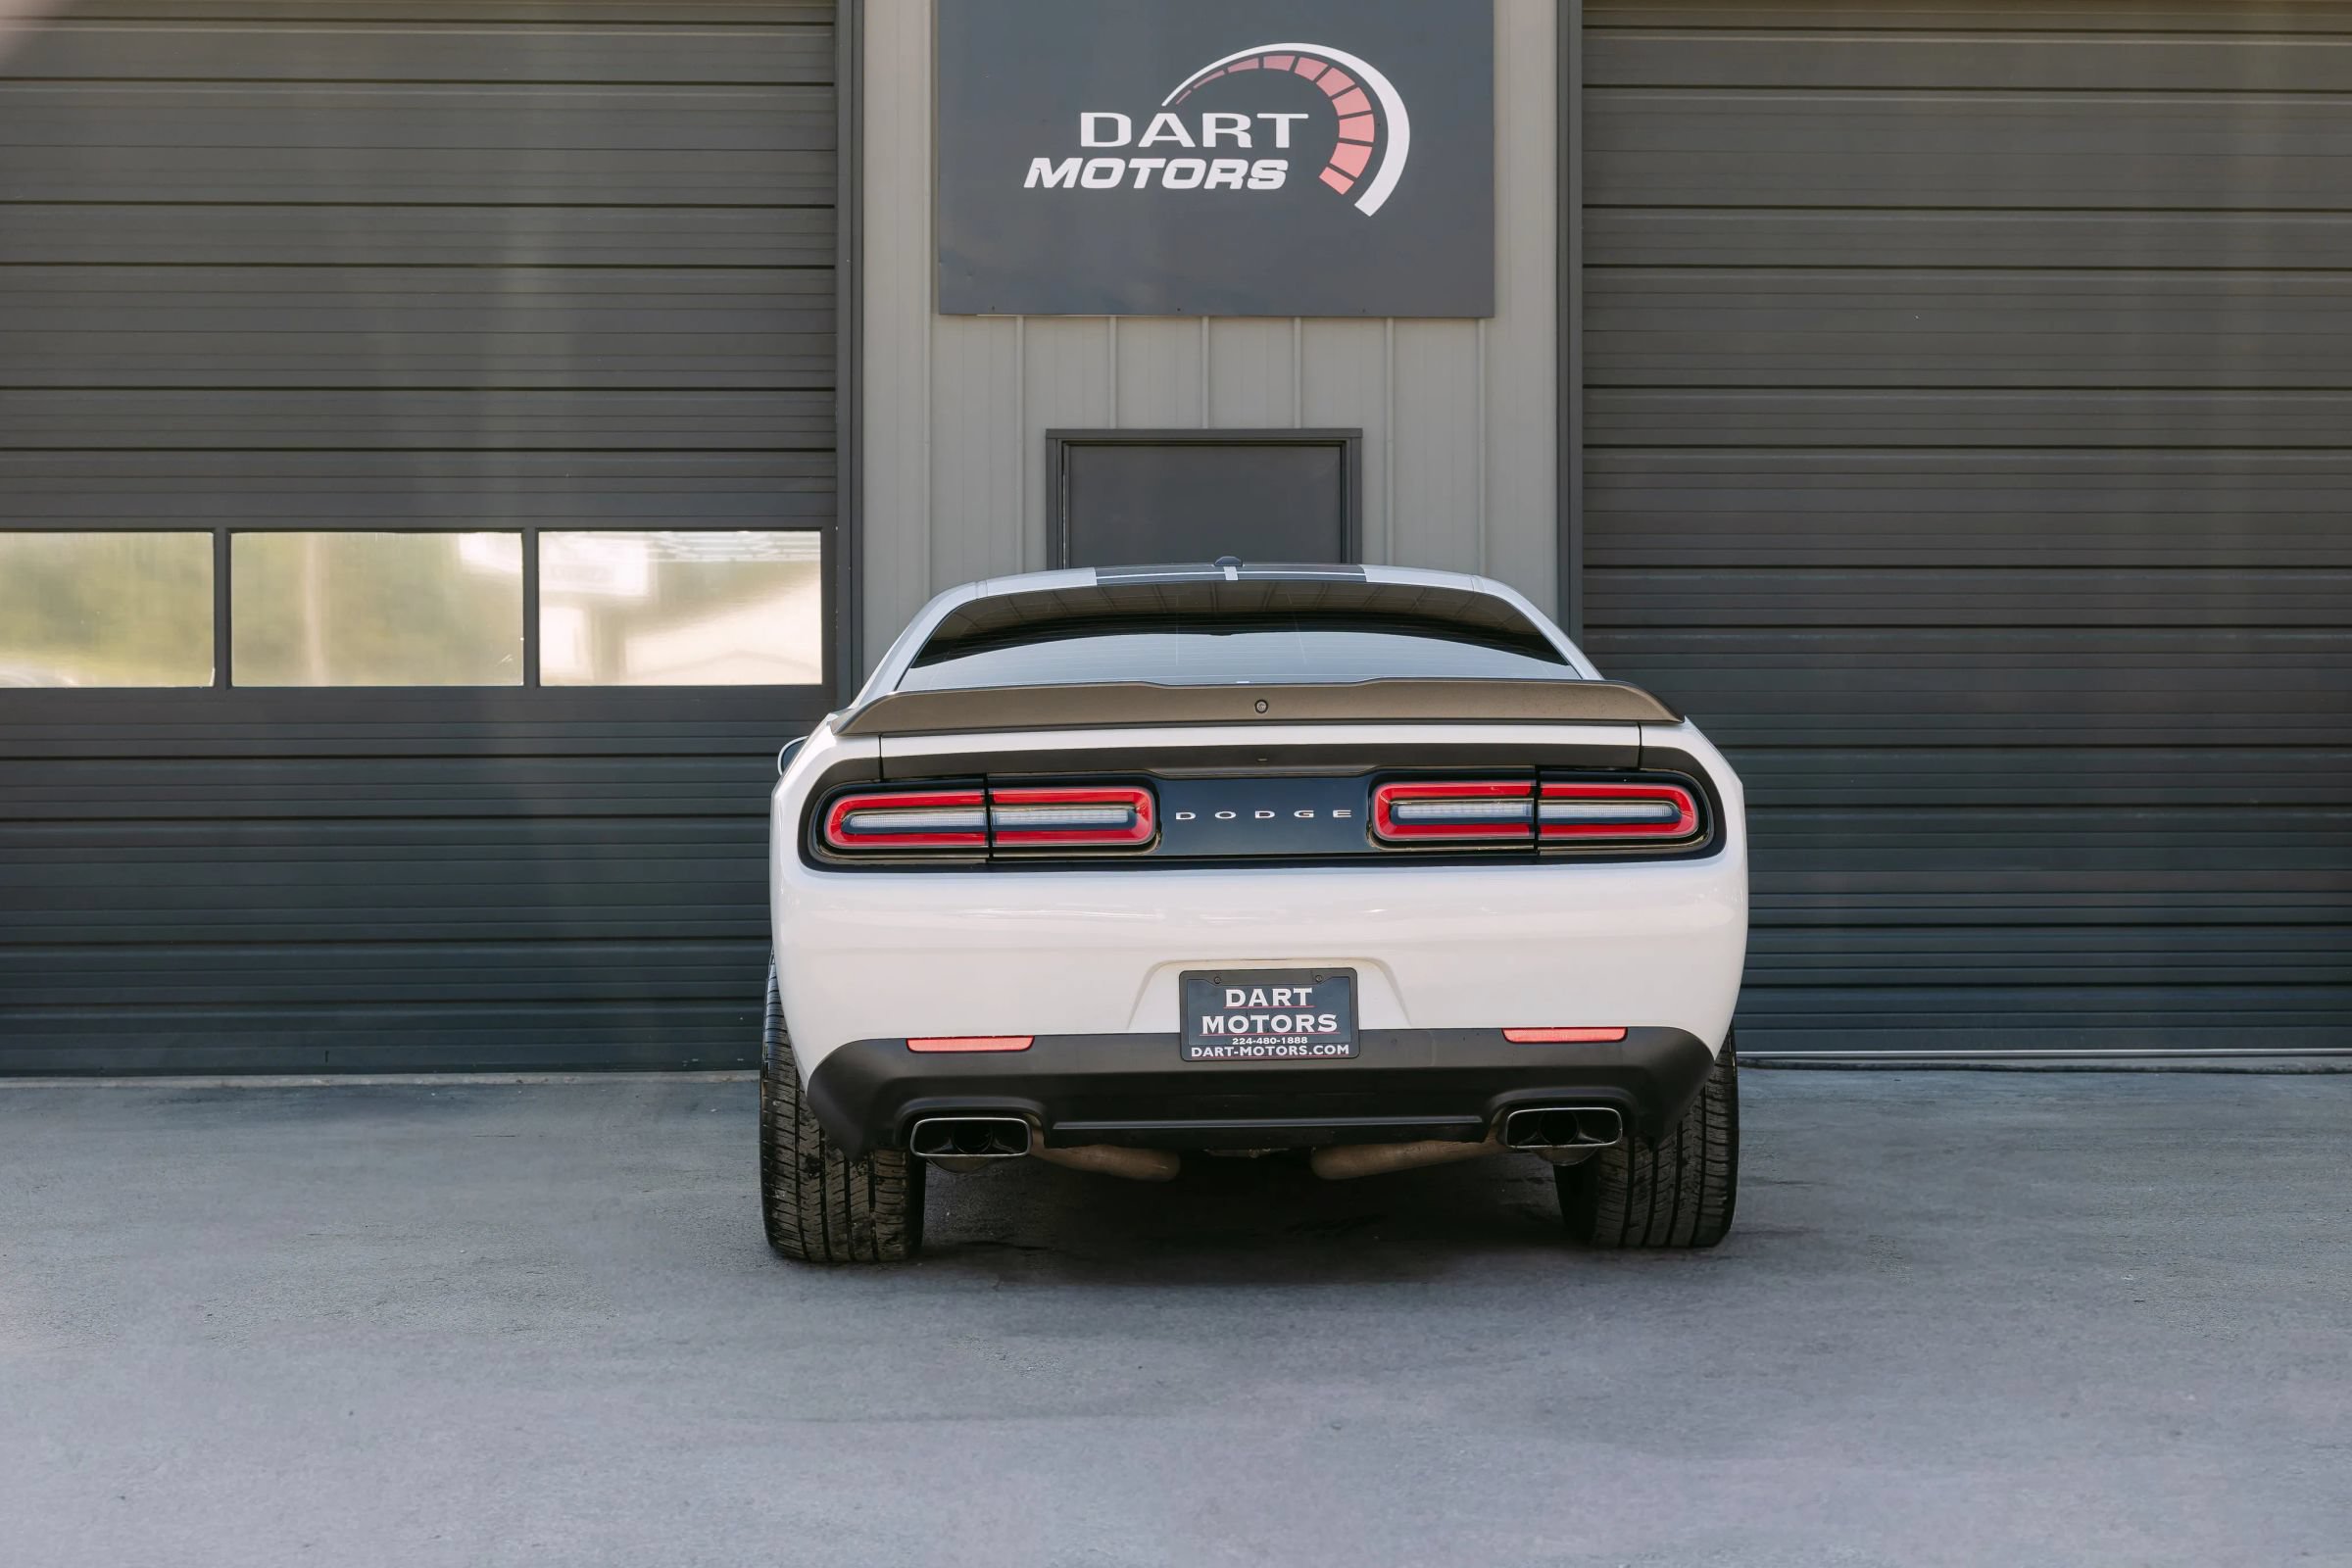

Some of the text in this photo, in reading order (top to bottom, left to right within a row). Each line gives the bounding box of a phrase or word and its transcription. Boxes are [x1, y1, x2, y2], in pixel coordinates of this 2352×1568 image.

[1080, 112, 1308, 148] DART
[1023, 158, 1289, 189] MOTORS
[1175, 809, 1352, 820] DODGE
[1225, 988, 1313, 1007] DART
[1201, 1013, 1338, 1035] MOTORS
[1232, 1036, 1308, 1045] 224-480-1888
[1191, 1045, 1349, 1057] DART-MOTORS.COM
